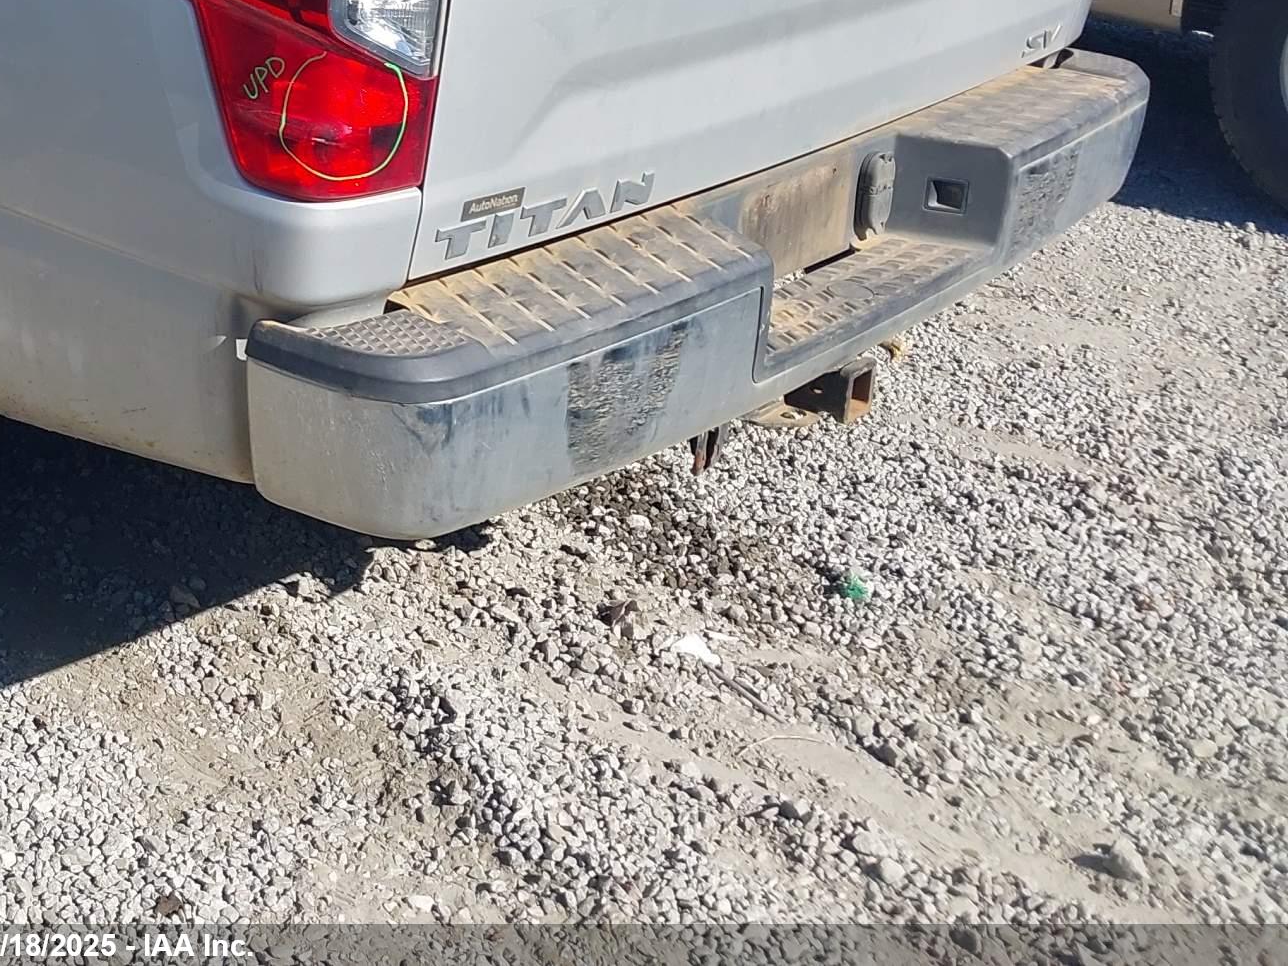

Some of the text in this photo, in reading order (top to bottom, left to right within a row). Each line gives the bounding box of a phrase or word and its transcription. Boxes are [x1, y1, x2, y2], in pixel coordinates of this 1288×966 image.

[1021, 23, 1062, 59] SV
[242, 56, 285, 100] UPD
[435, 171, 655, 260] TITAN
[469, 192, 519, 215] AutoNation
